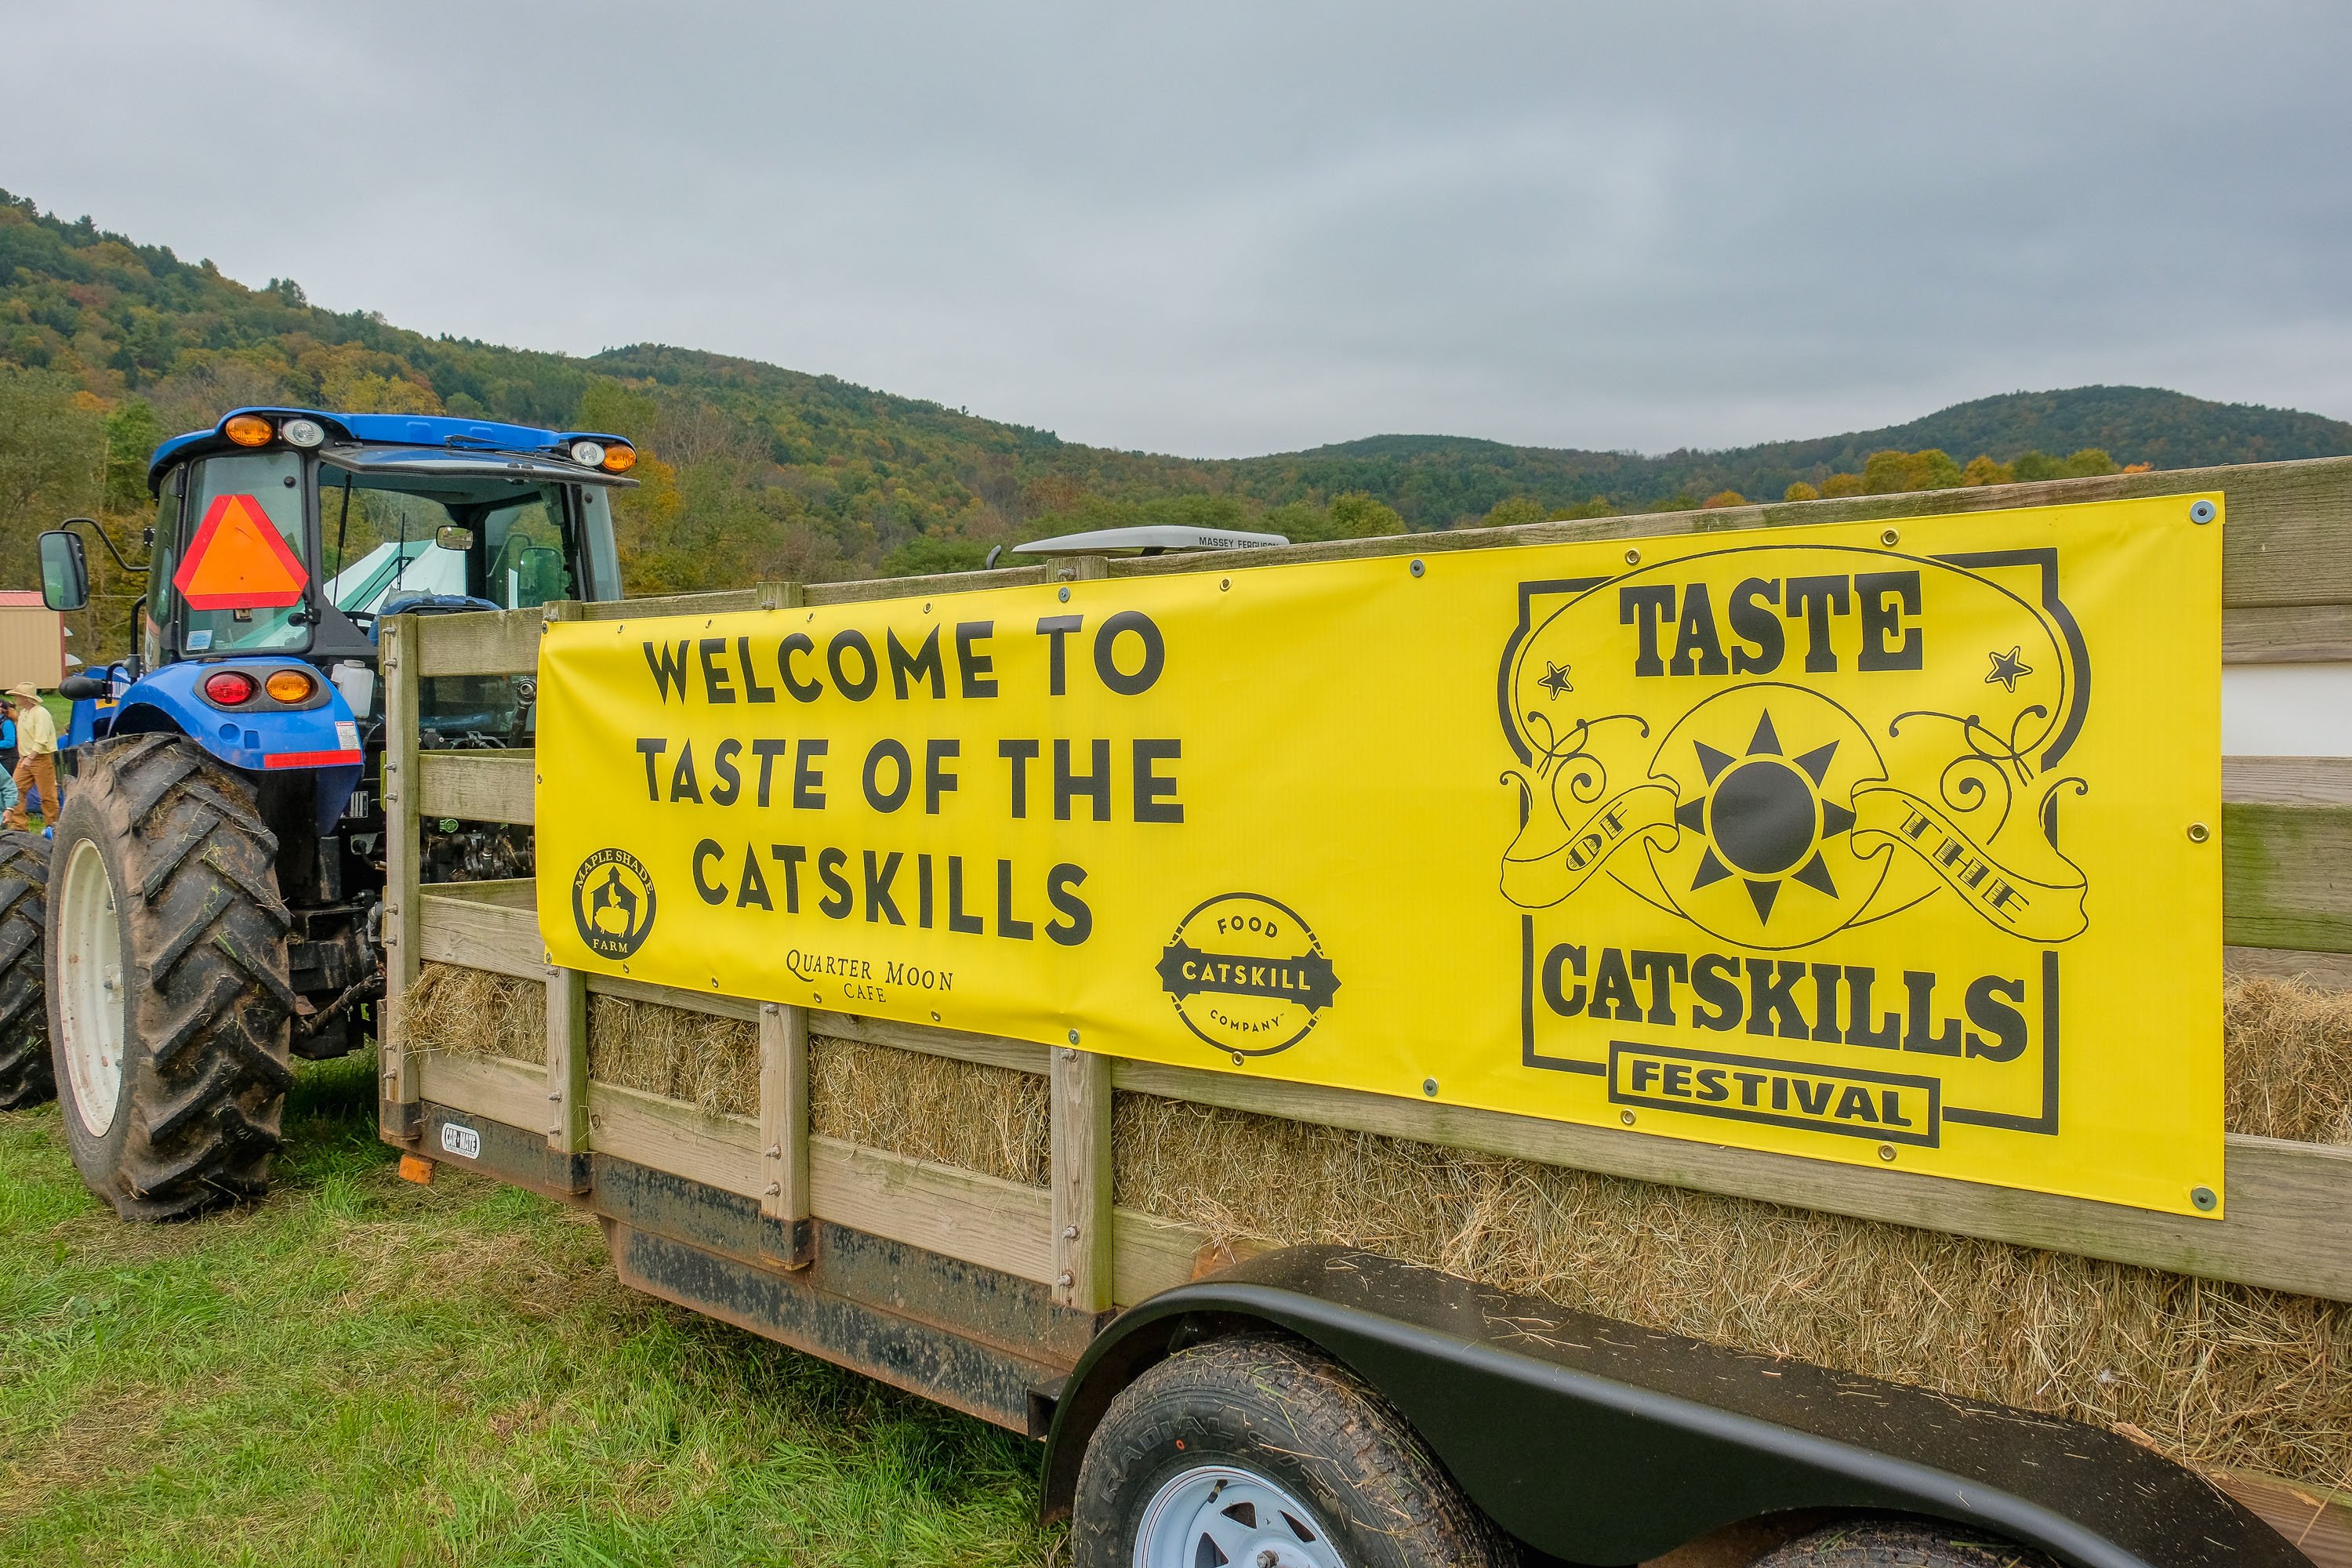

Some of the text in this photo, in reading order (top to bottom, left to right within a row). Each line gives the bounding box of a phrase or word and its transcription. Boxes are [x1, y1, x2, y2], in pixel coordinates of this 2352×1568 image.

[1199, 536, 1279, 549] MASSEY FERGU
[1619, 570, 1924, 677] TASTE
[642, 610, 1165, 706] WELCOME TO
[636, 737, 1185, 824] TASTE OF THE
[575, 850, 654, 895] MAPLE SHADE
[692, 838, 1093, 946] CATSKILLS
[1566, 799, 2030, 924] OF THE
[592, 938, 628, 953] FARM
[1217, 915, 1278, 938] FOOD
[844, 982, 887, 1003] CAFE
[1181, 960, 1311, 991] CATSKILL
[1541, 942, 2028, 1063] CATSKILLS
[1210, 1009, 1279, 1033] COMPANY
[1631, 1059, 1912, 1127] FESTIVAL
[1100, 1416, 1236, 1504] RADIAL
